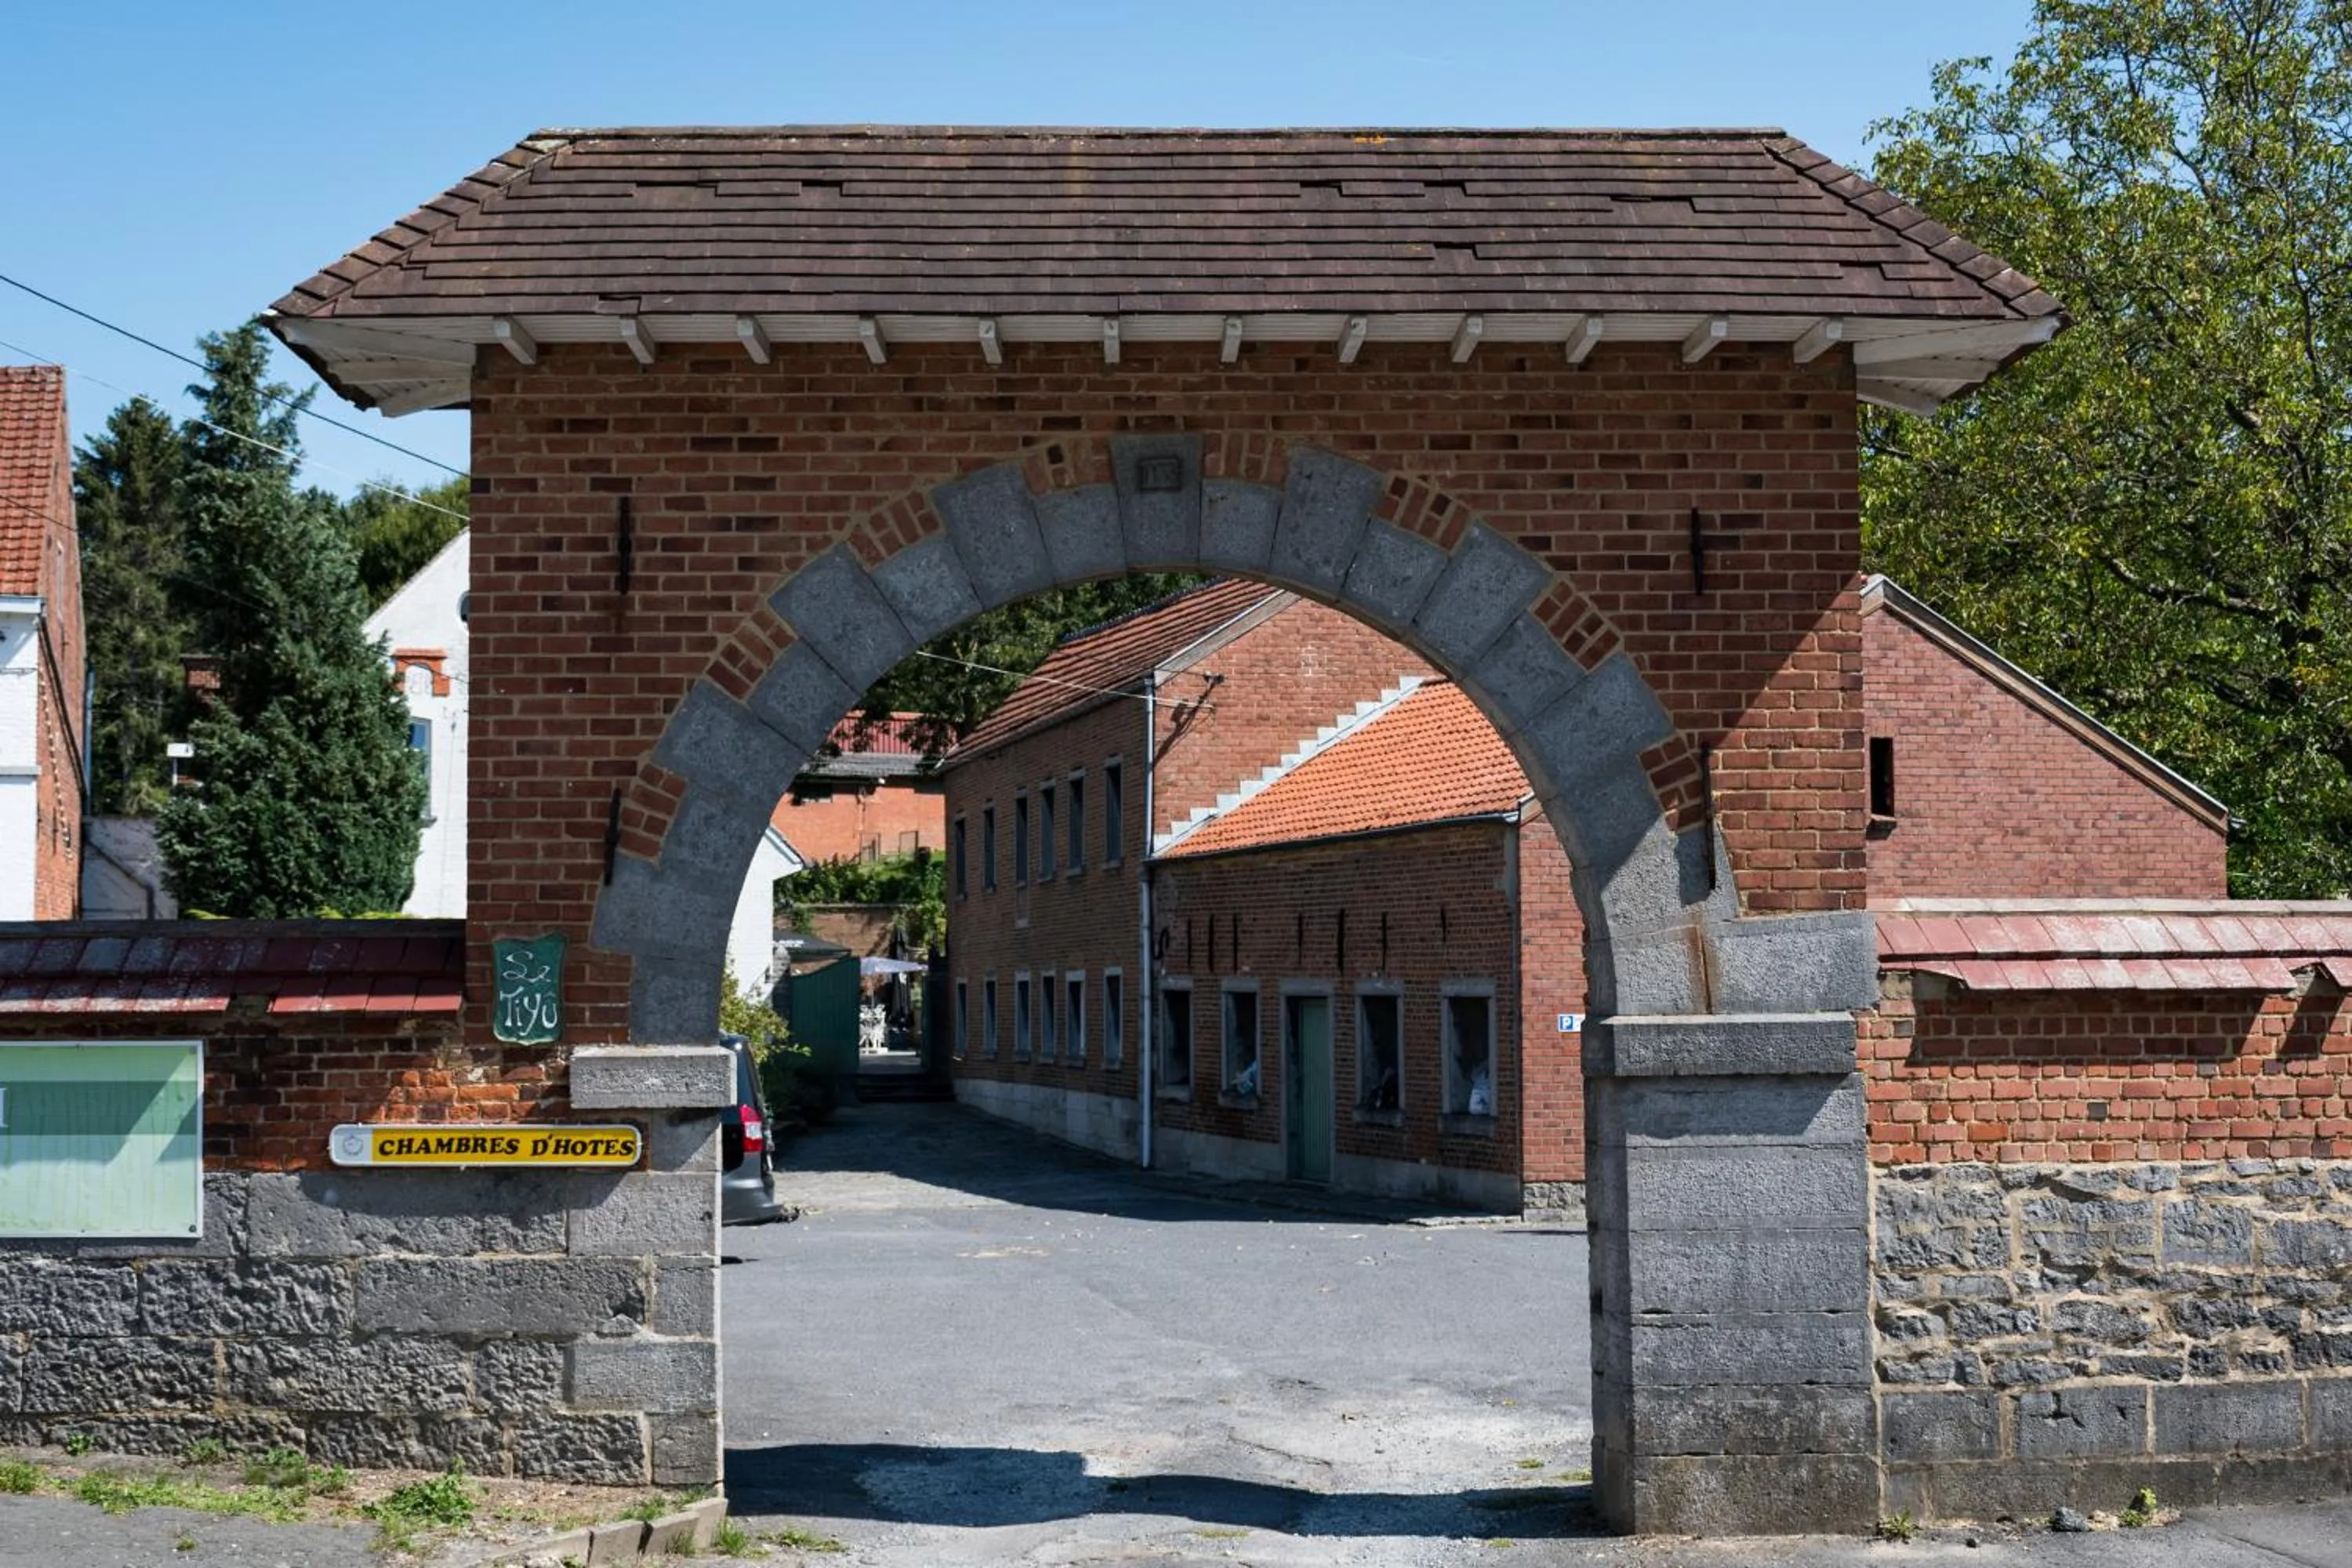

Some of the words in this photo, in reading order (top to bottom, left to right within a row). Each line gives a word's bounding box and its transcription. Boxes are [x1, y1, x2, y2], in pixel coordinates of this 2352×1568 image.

[1563, 1016, 1572, 1029] P
[379, 1137, 521, 1156] CHAMBRES
[530, 1134, 634, 1156] D'HOTES
